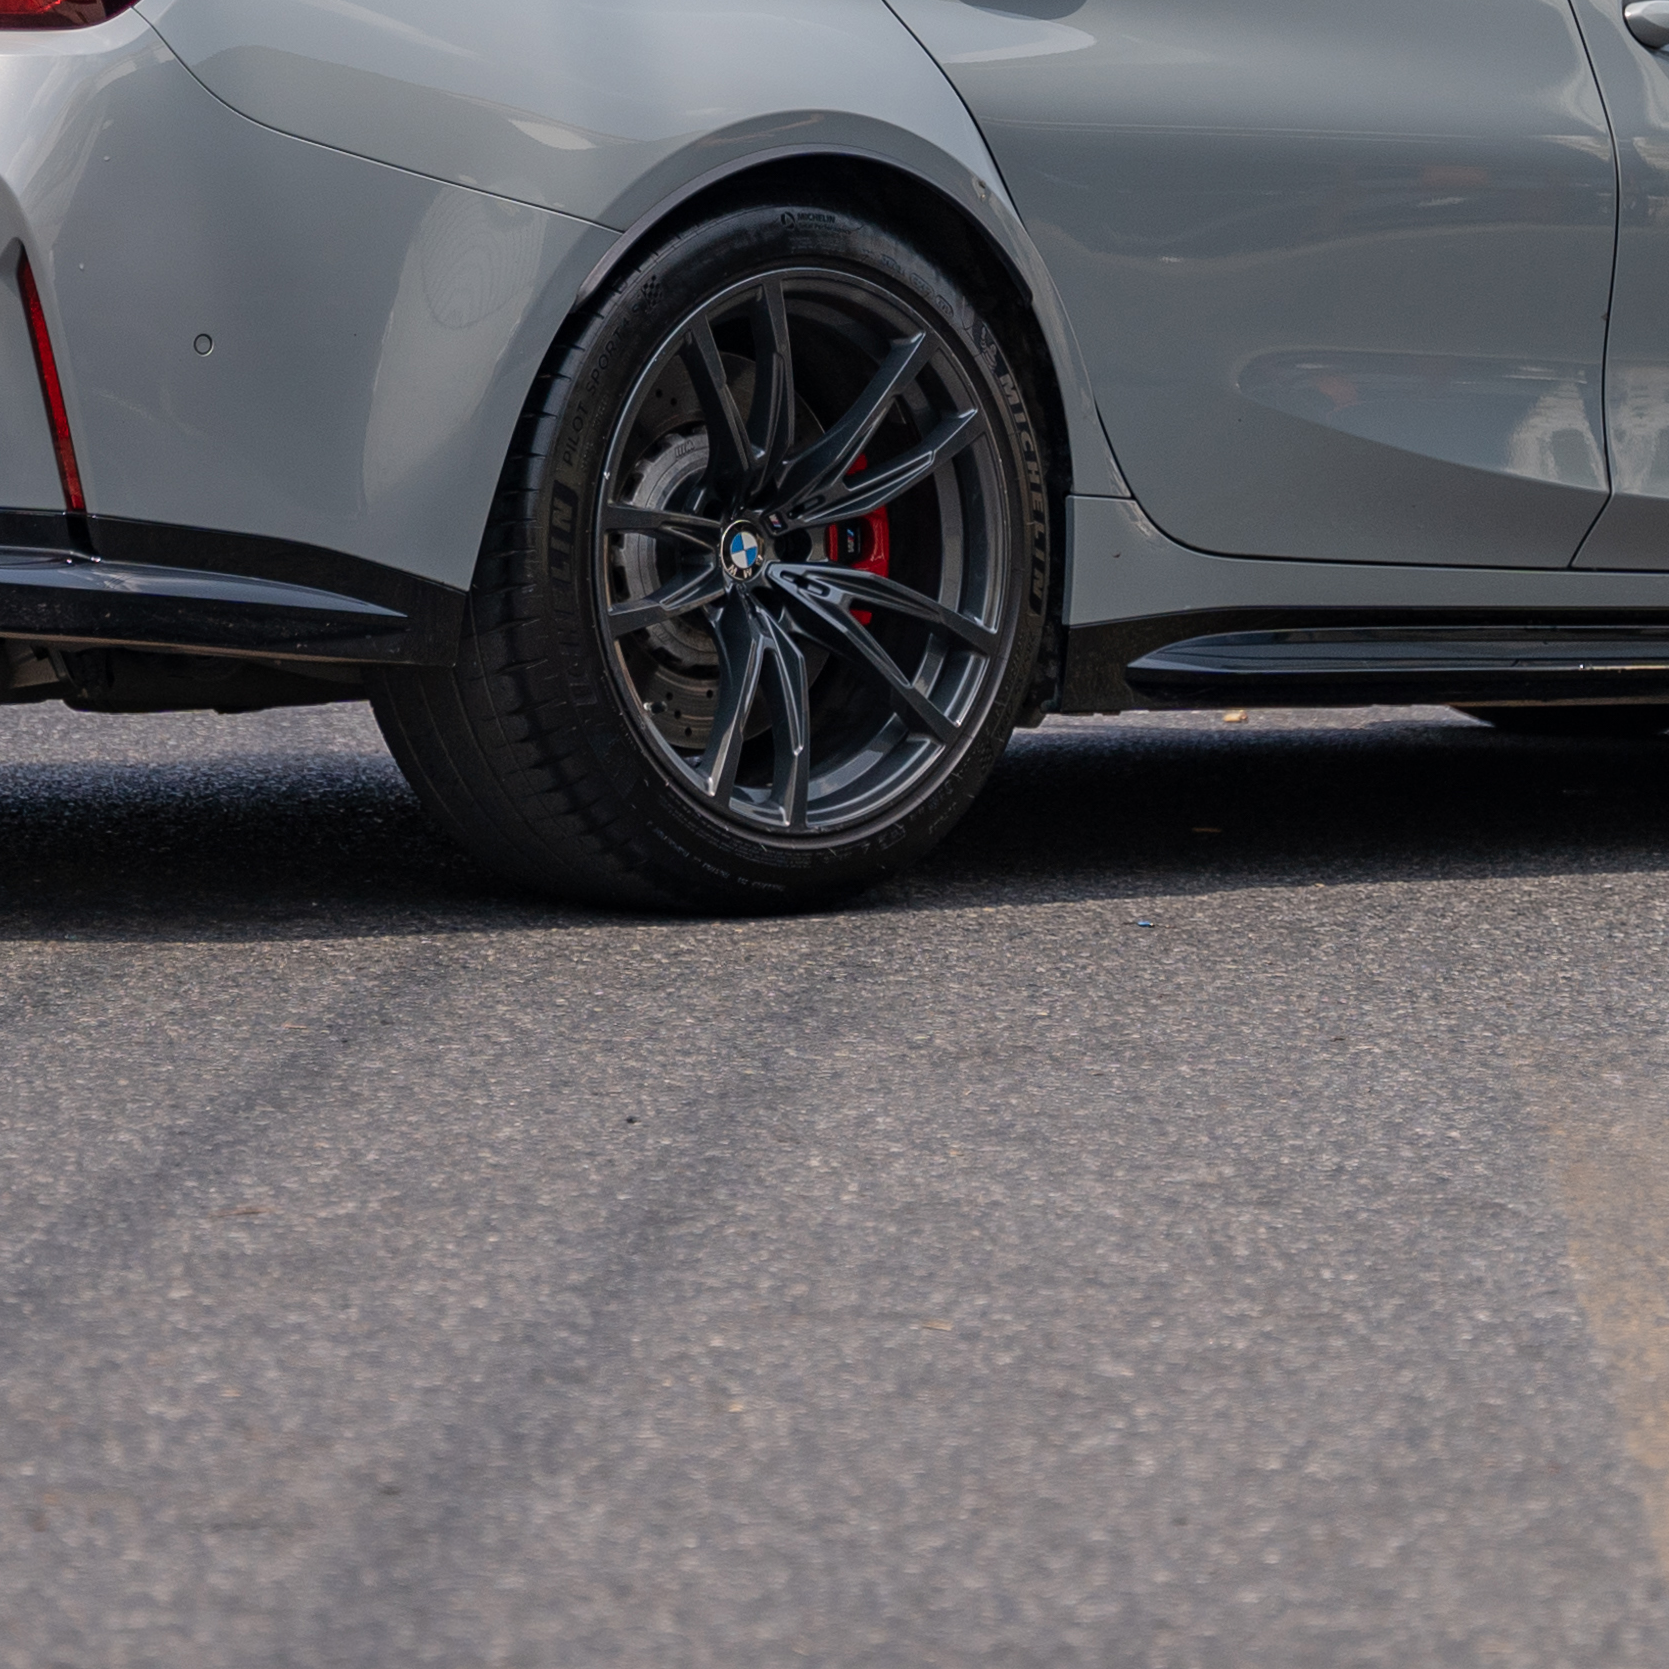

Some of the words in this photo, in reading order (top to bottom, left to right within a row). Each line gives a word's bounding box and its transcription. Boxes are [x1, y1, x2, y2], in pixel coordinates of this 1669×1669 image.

[797, 212, 836, 224] MICHELIN
[562, 401, 587, 466] PILOT
[586, 326, 622, 396] SPORT
[999, 373, 1043, 599] MICHELIN
